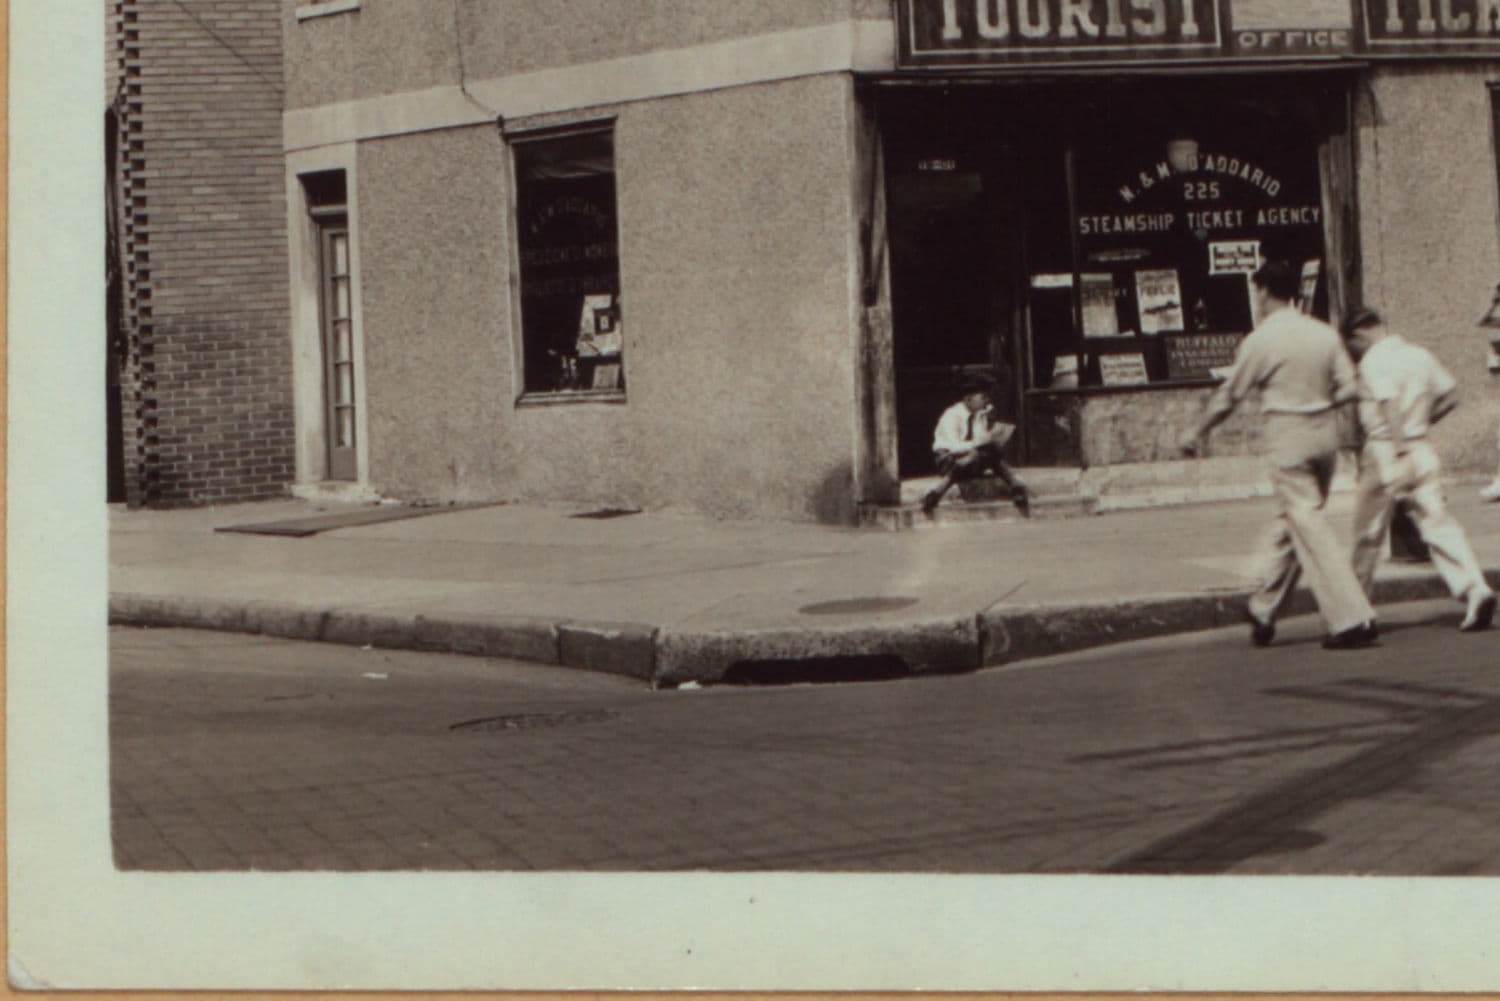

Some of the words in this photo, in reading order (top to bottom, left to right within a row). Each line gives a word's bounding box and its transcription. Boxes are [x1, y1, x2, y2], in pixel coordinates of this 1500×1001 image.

[1238, 31, 1349, 50] OFFICE
[1139, 171, 1155, 189] &
[1186, 153, 1282, 199] D'ADDARIO
[1183, 181, 1221, 201] 225
[1079, 212, 1176, 235] STEAMSHIP
[1187, 209, 1244, 231] TICKET
[1256, 206, 1321, 227] AGENCY
[1174, 335, 1238, 349] BUFFALO
